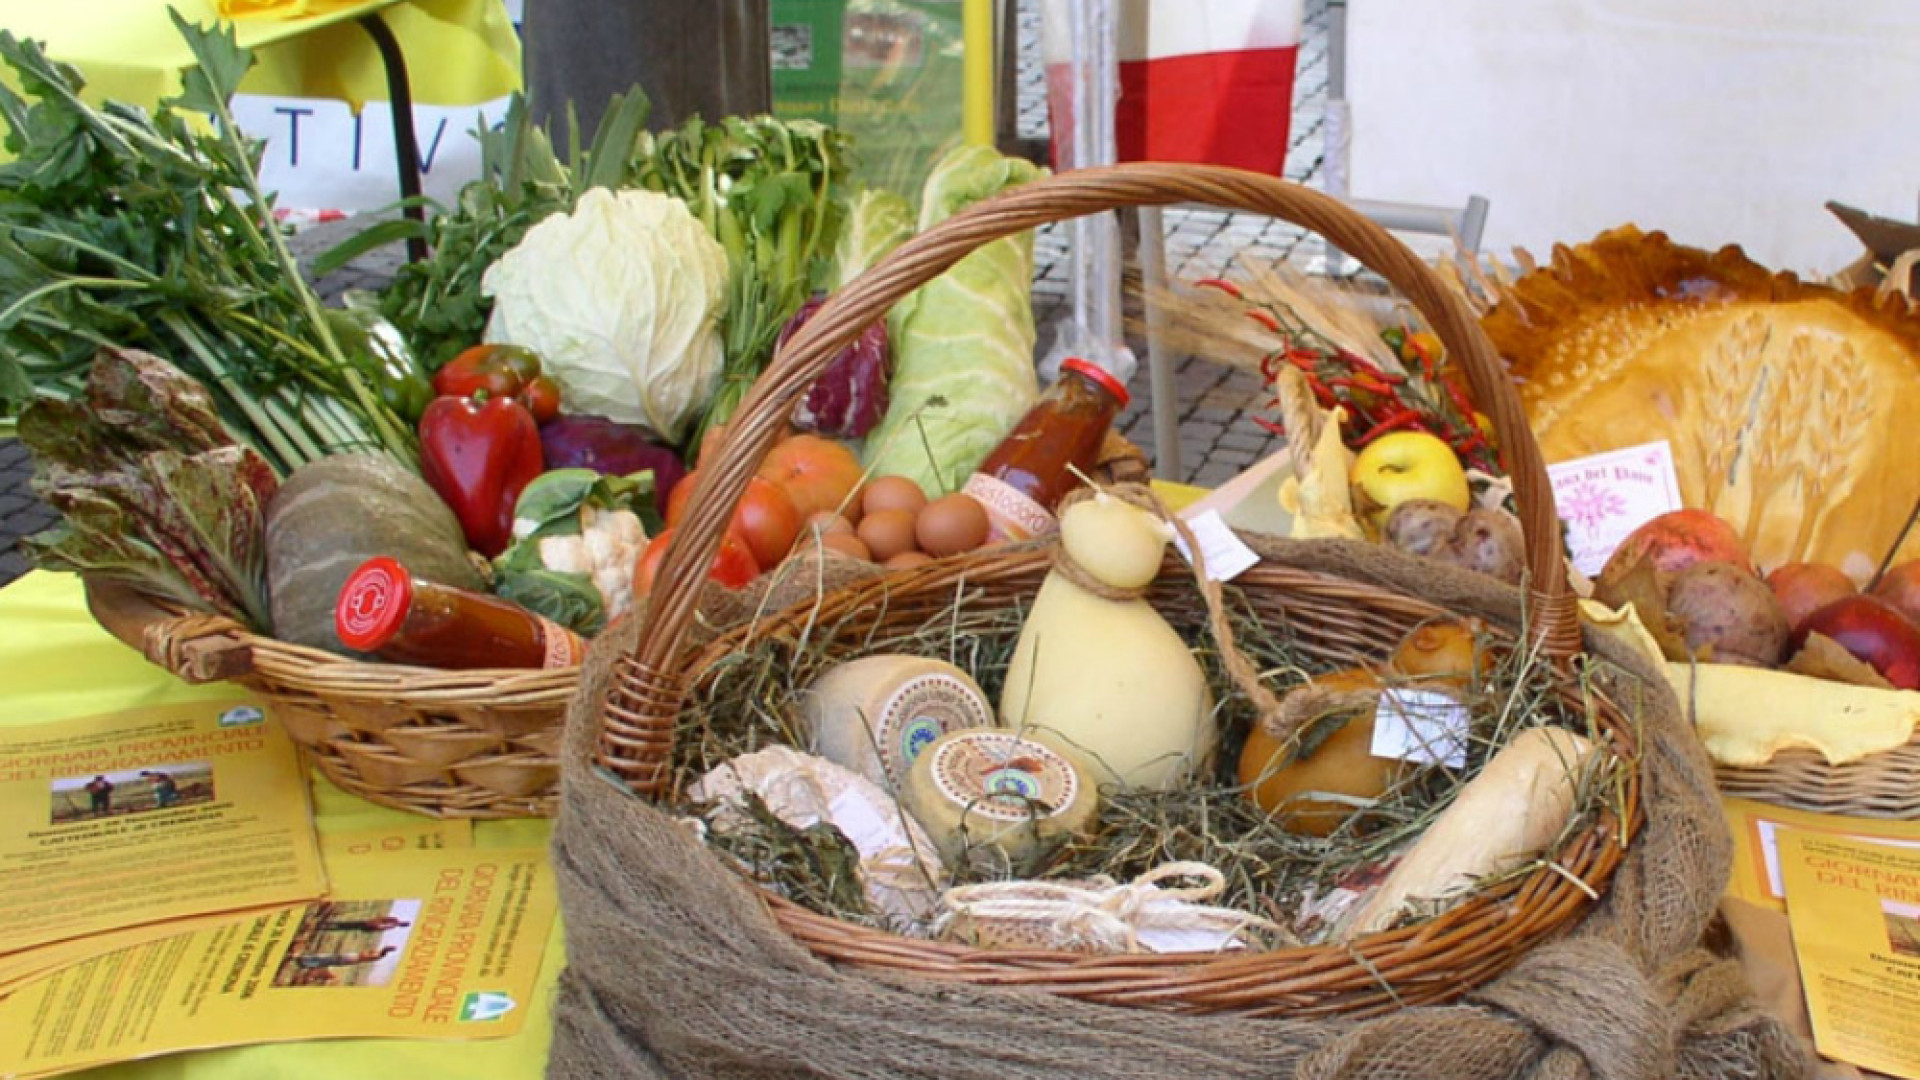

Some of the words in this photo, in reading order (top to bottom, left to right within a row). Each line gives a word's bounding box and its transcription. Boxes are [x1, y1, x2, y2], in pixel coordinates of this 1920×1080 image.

[50, 740, 264, 779] RINGRAZIAMENTO
[117, 724, 269, 756] PROVINCIALE
[434, 867, 464, 895] DEL
[456, 862, 499, 931] GIORNATA
[388, 896, 455, 1019] RINGRAZIAMENTO
[422, 931, 476, 1024] PROVINCIALE
